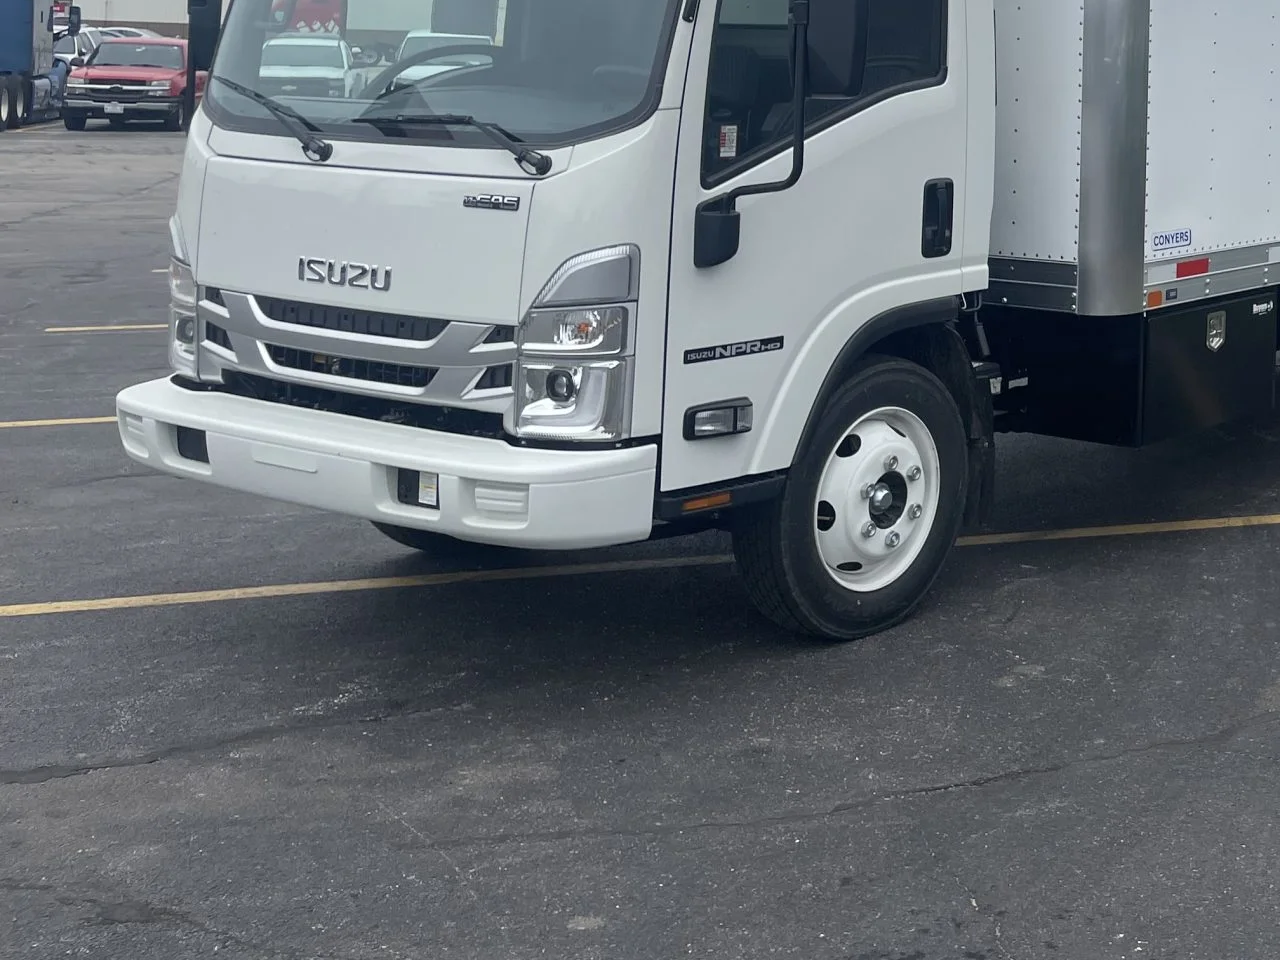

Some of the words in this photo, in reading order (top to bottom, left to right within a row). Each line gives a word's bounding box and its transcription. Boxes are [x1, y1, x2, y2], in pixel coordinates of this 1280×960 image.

[1153, 231, 1189, 246] CONYERS
[298, 255, 392, 292] ISUZU
[687, 349, 714, 361] ISUZU
[715, 341, 761, 358] NPR
